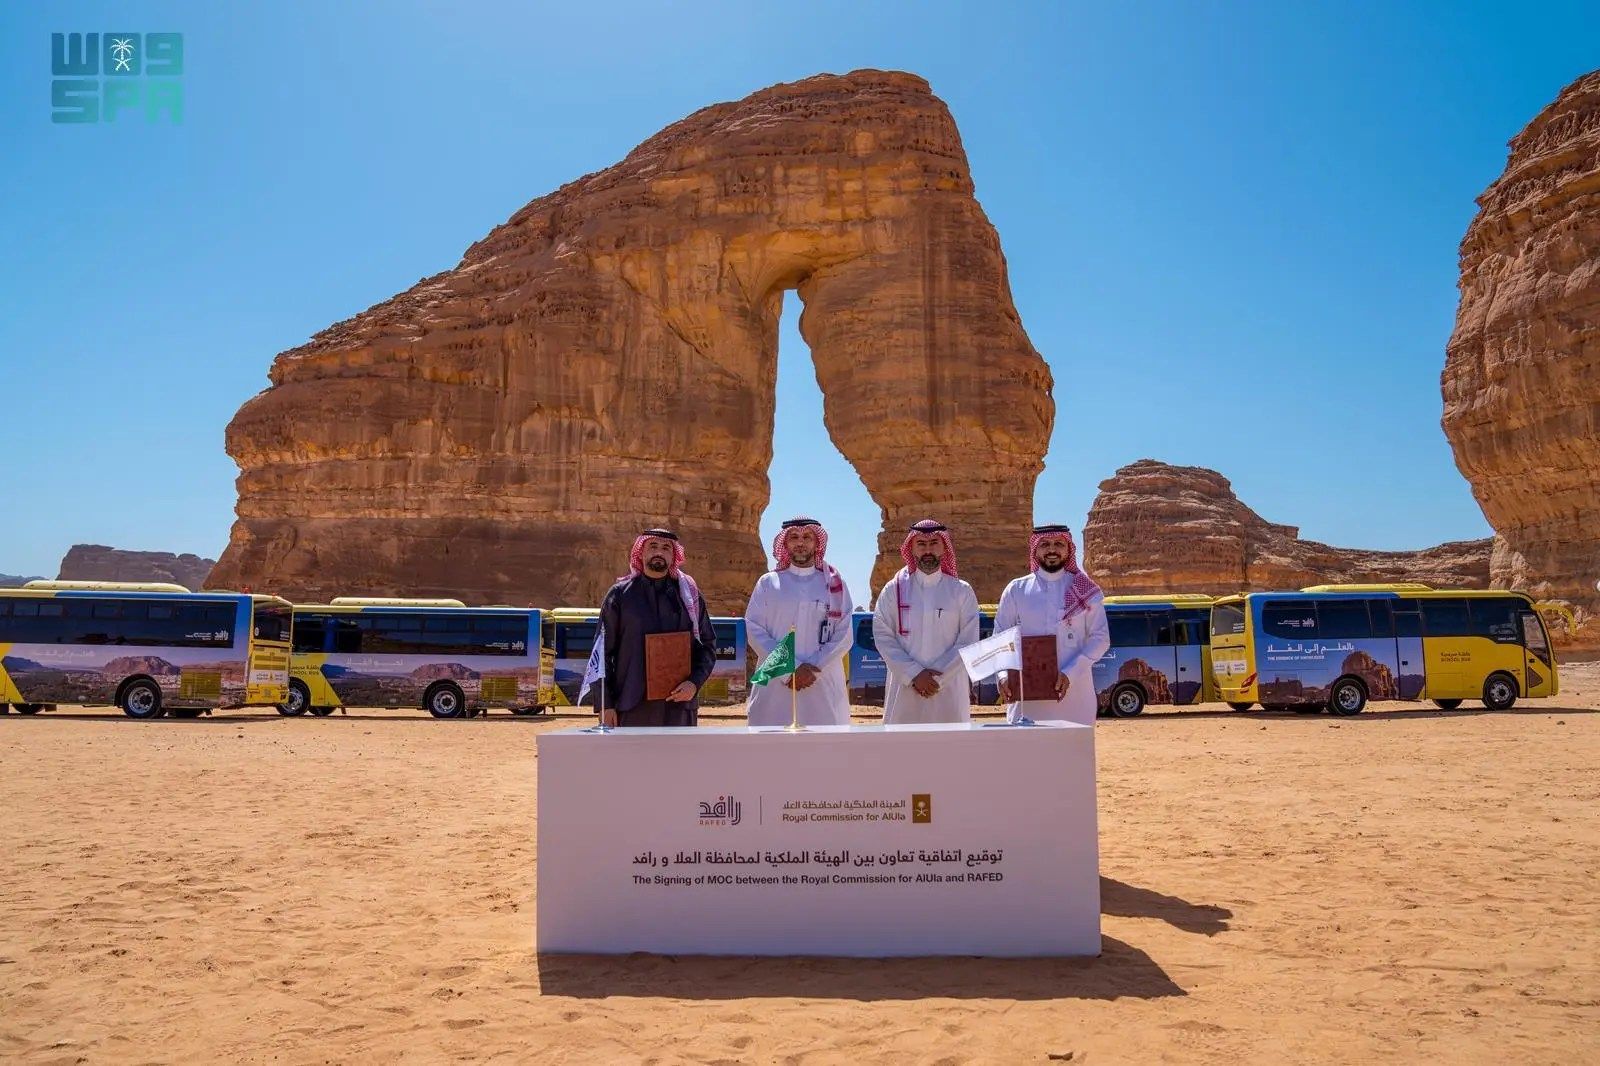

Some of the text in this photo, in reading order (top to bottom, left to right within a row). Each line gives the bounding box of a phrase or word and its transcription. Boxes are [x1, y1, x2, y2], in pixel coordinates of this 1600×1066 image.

[699, 795, 742, 826] رافد
[801, 799, 843, 810] لمحافظة
[843, 799, 878, 811] الملكية
[879, 799, 906, 811] الهيئة
[782, 812, 906, 824] Royal Commission for AlUla
[632, 848, 1004, 868] توقيع اتفاقية تعاون بين الهيئة الملكية لمحافظة العلا و رافد
[631, 871, 1004, 887] The Signing of MOC between the Royal Commission for AlUla and RAFED
